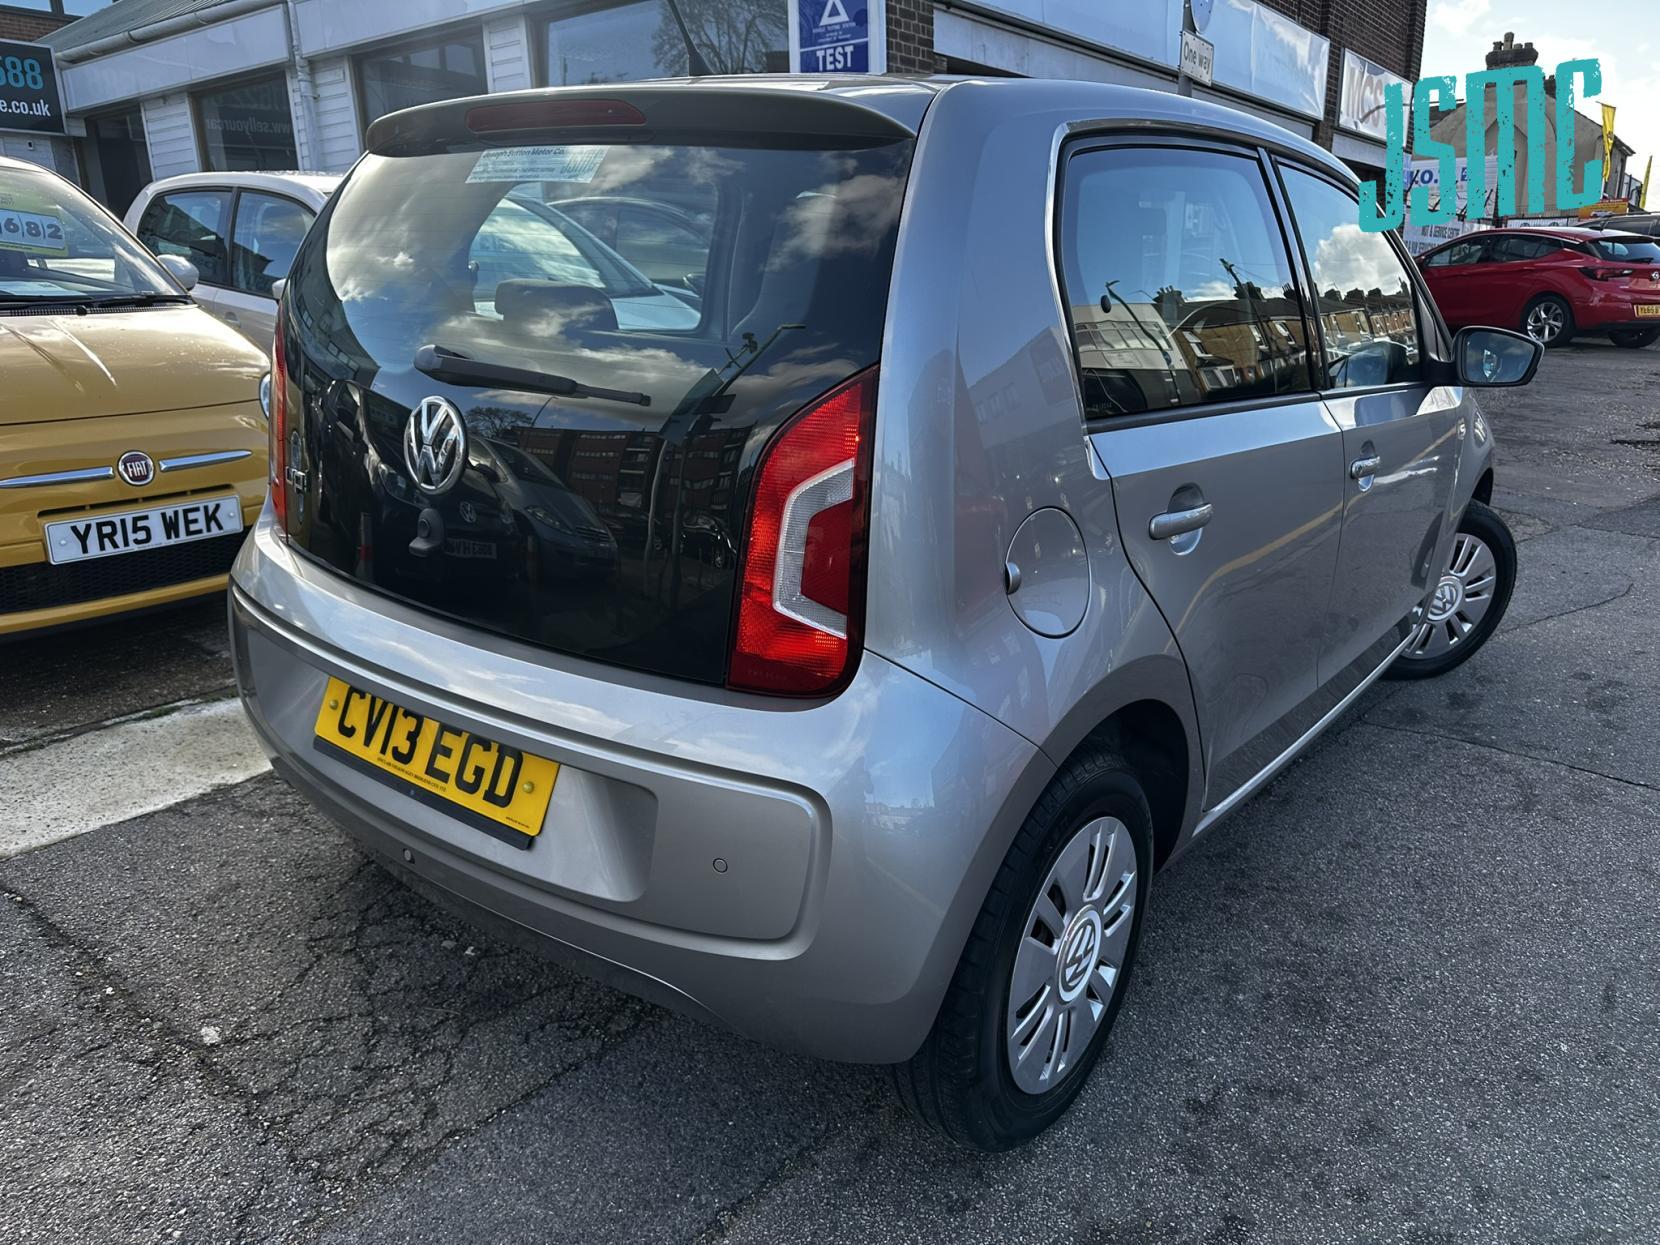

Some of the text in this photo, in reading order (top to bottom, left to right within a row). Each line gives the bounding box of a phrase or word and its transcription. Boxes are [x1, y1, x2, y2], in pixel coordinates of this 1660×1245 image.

[816, 45, 854, 71] TEST
[1184, 41, 1211, 75] One way
[126, 461, 148, 478] FIAT
[70, 502, 225, 554] YR15 WEK
[337, 685, 425, 766] CV13
[425, 722, 524, 808] EGD
